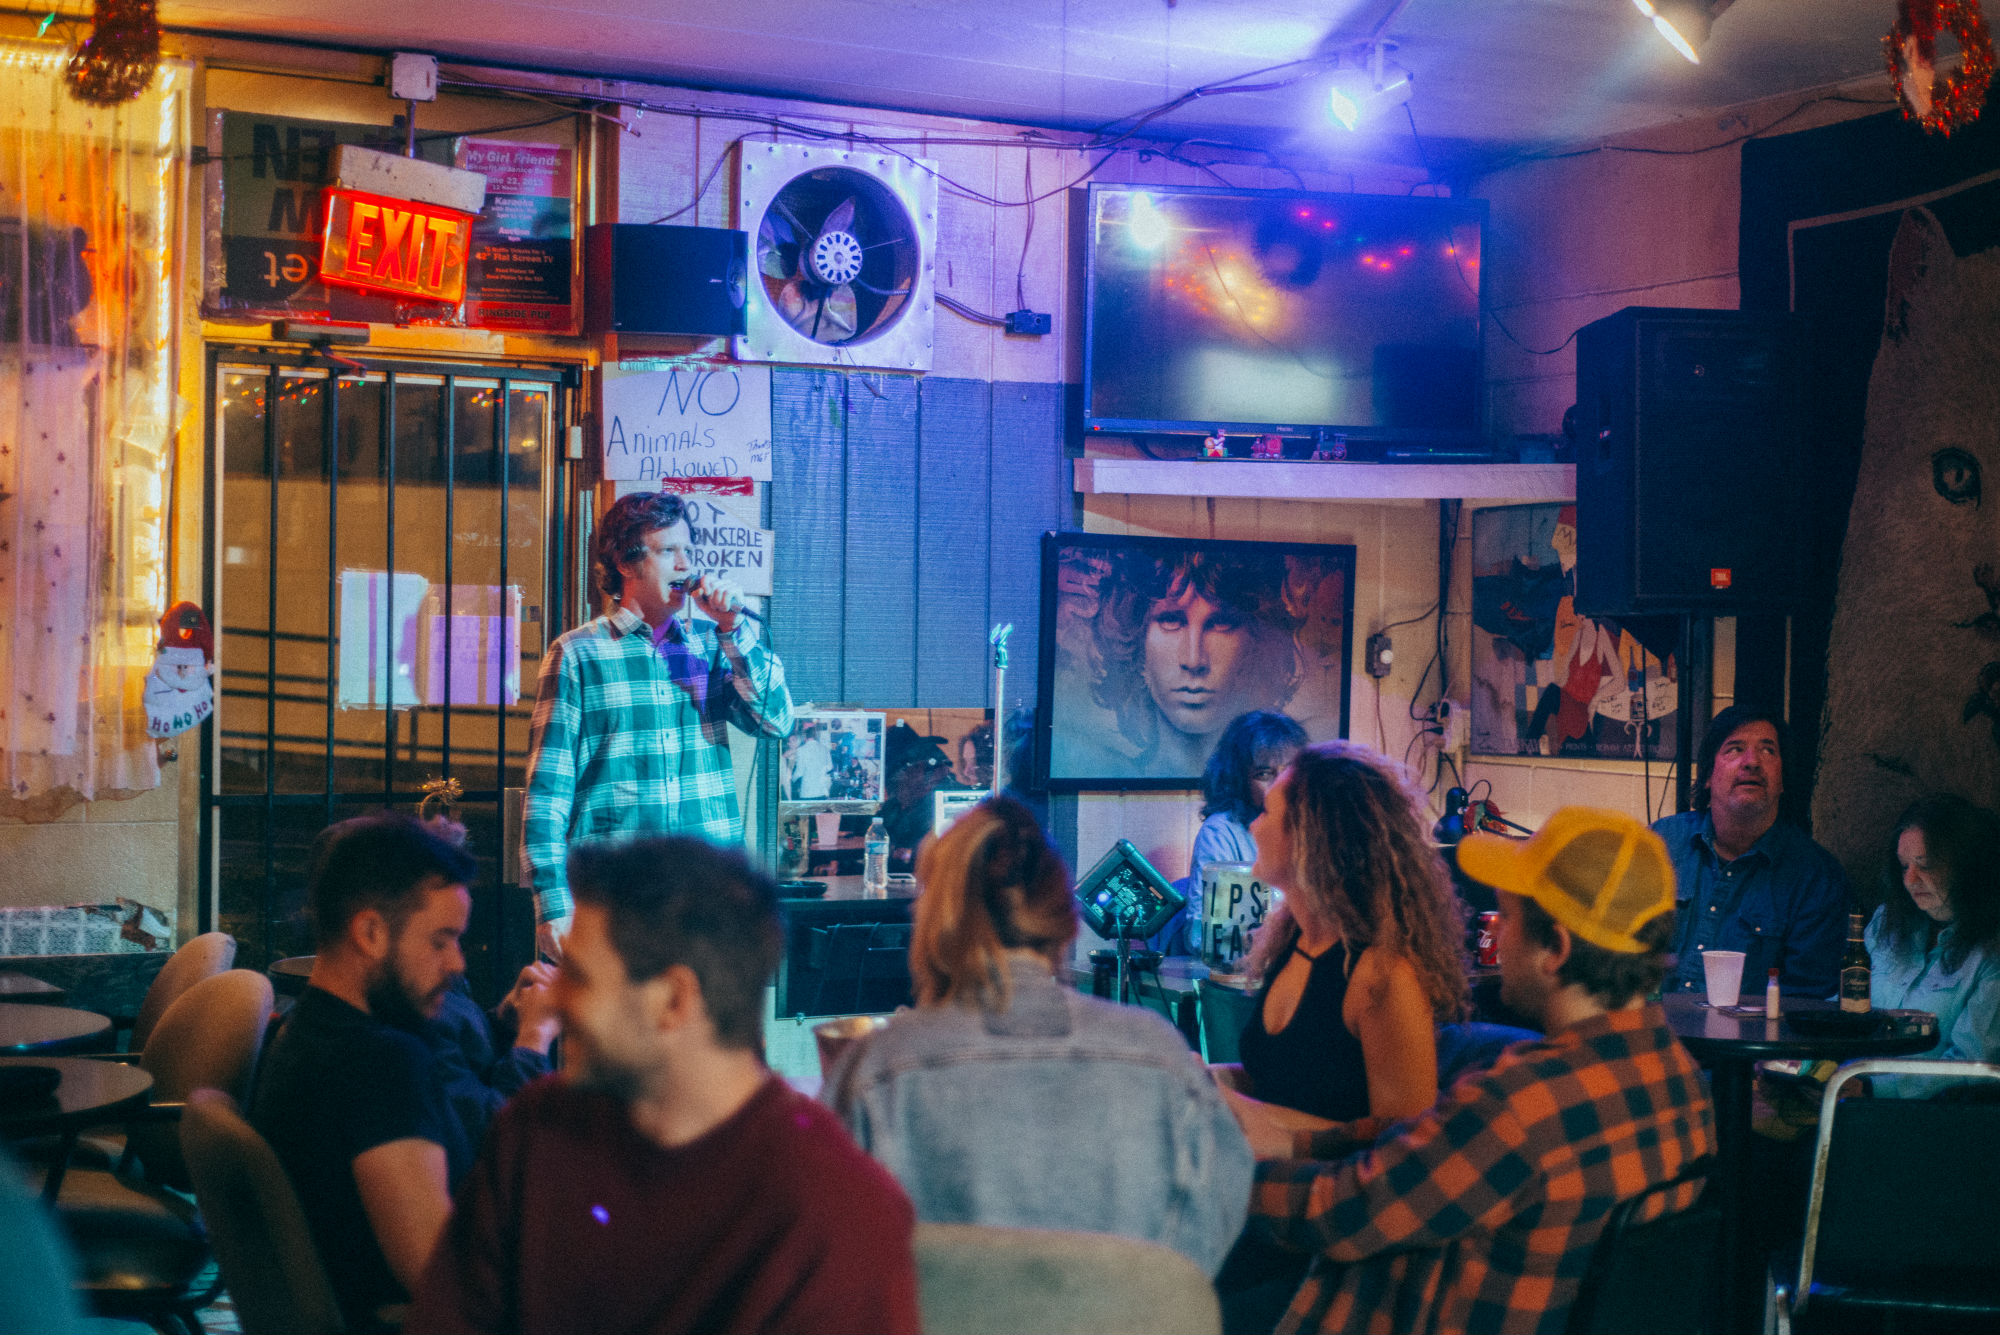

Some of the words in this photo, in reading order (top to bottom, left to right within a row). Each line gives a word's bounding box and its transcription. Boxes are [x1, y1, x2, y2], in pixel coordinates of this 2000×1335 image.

[487, 151, 510, 163] Girl
[514, 152, 561, 166] Friends
[346, 202, 457, 288] EXIT
[478, 308, 526, 318] RINGSIDE
[657, 371, 740, 416] NO
[685, 501, 725, 525] OT
[690, 526, 763, 548] ONSIBLE
[691, 549, 763, 568] ROKEN
